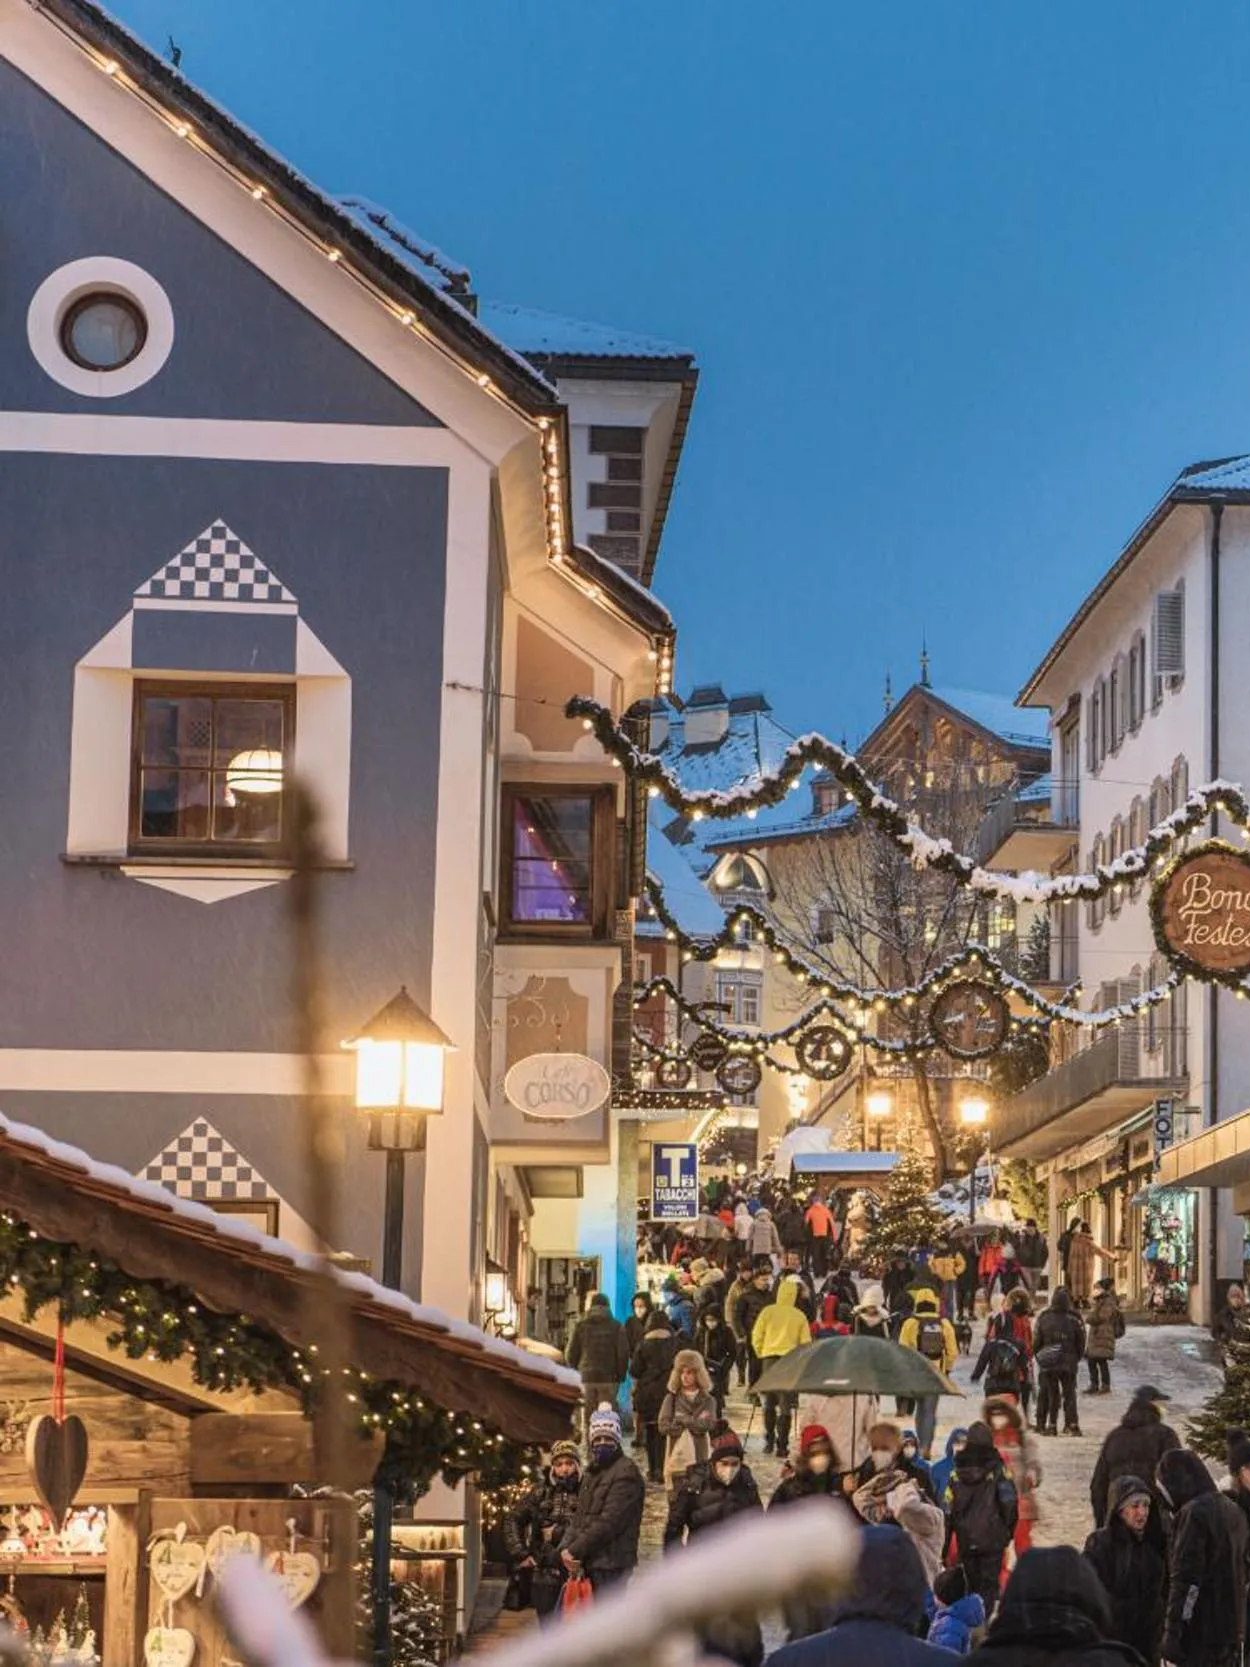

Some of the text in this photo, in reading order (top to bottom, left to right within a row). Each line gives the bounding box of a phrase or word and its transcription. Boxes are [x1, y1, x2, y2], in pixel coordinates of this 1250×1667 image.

[523, 1081, 591, 1109] CORSO
[661, 1148, 690, 1187] T
[655, 1188, 697, 1201] TABACCHI
